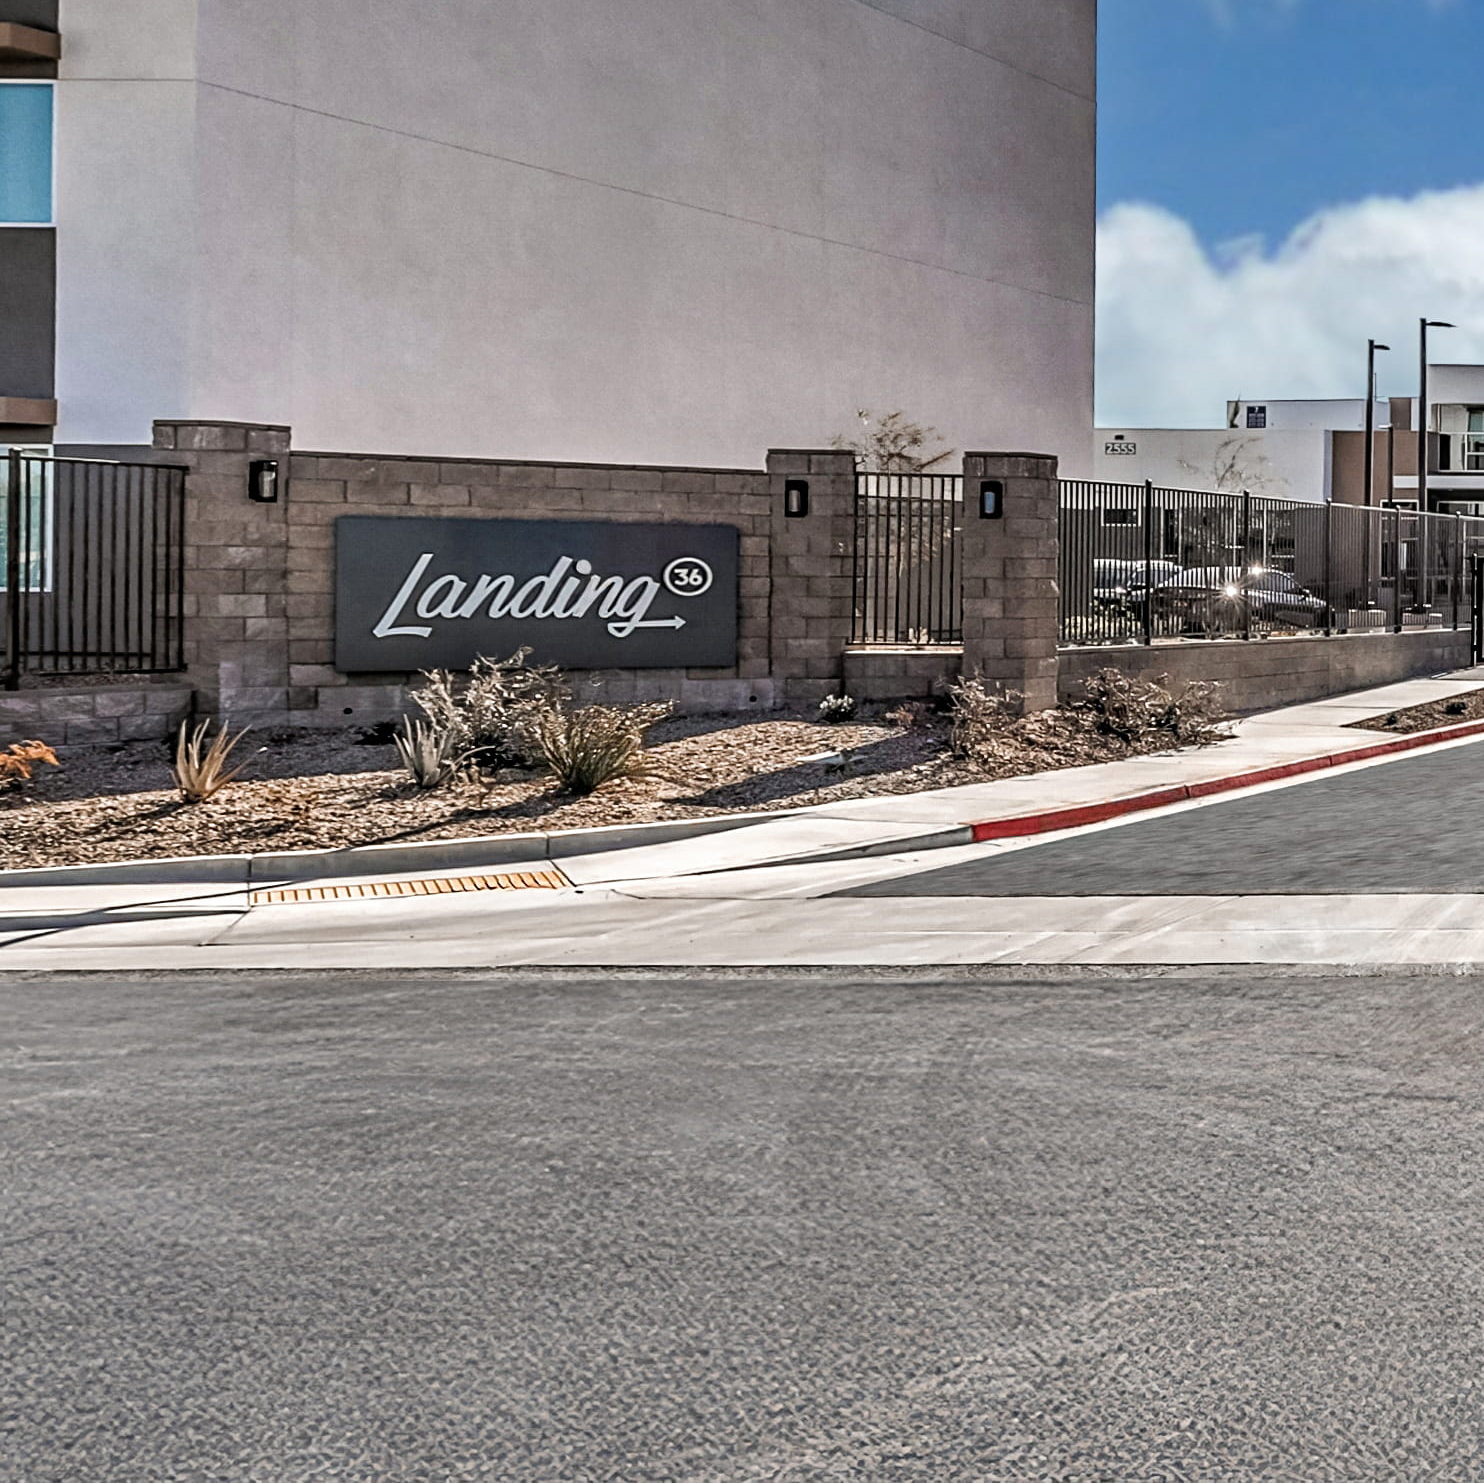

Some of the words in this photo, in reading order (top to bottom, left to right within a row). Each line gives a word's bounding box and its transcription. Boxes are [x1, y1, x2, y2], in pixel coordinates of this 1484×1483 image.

[1106, 443, 1135, 454] 2555
[372, 552, 663, 639] Landing
[673, 567, 704, 587] 36
